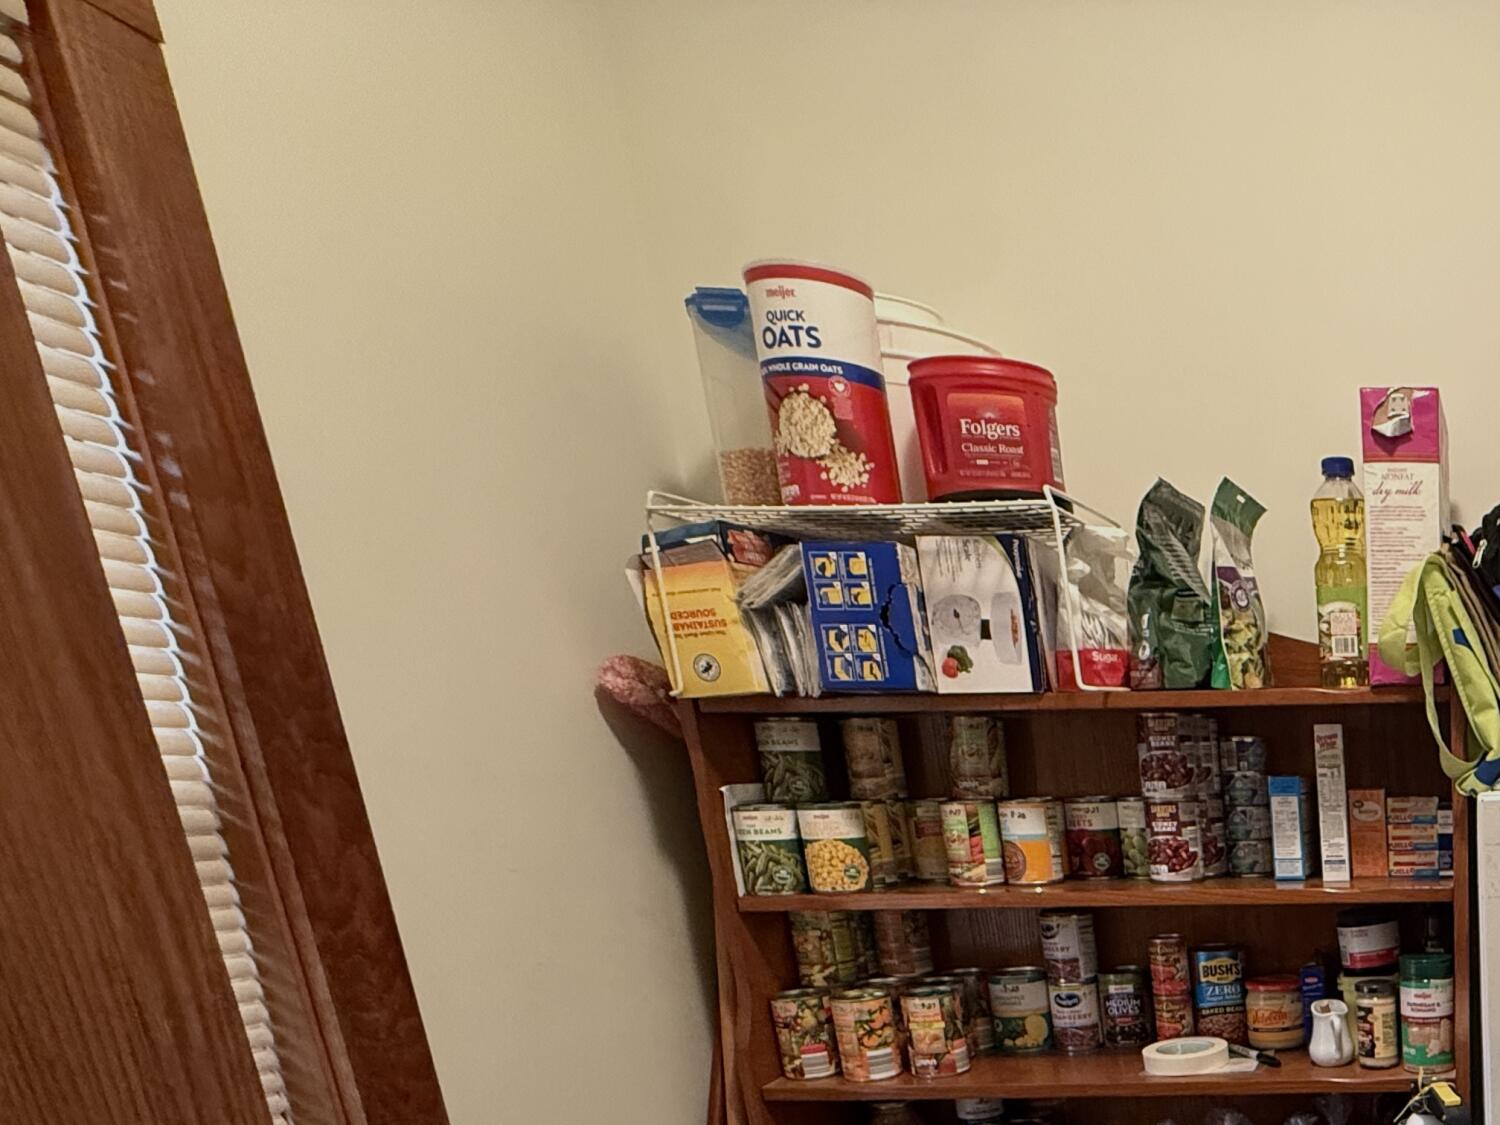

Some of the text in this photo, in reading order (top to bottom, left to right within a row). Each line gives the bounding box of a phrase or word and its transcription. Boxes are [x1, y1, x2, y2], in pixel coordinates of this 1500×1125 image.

[765, 285, 796, 299] meijer
[766, 309, 805, 325] QUICK
[762, 325, 822, 349] OATS
[769, 361, 791, 372] WHOLE
[792, 362, 819, 371] GRAIN
[820, 364, 843, 375] OATS
[959, 418, 1021, 440] Folgers
[961, 442, 1024, 454] Classic Roast
[1371, 480, 1423, 504] dry milk
[671, 618, 728, 632] SUSTAINAB
[753, 827, 782, 836] BEANS
[1201, 963, 1241, 979] BUSH'S
[1206, 984, 1241, 996] ZERO
